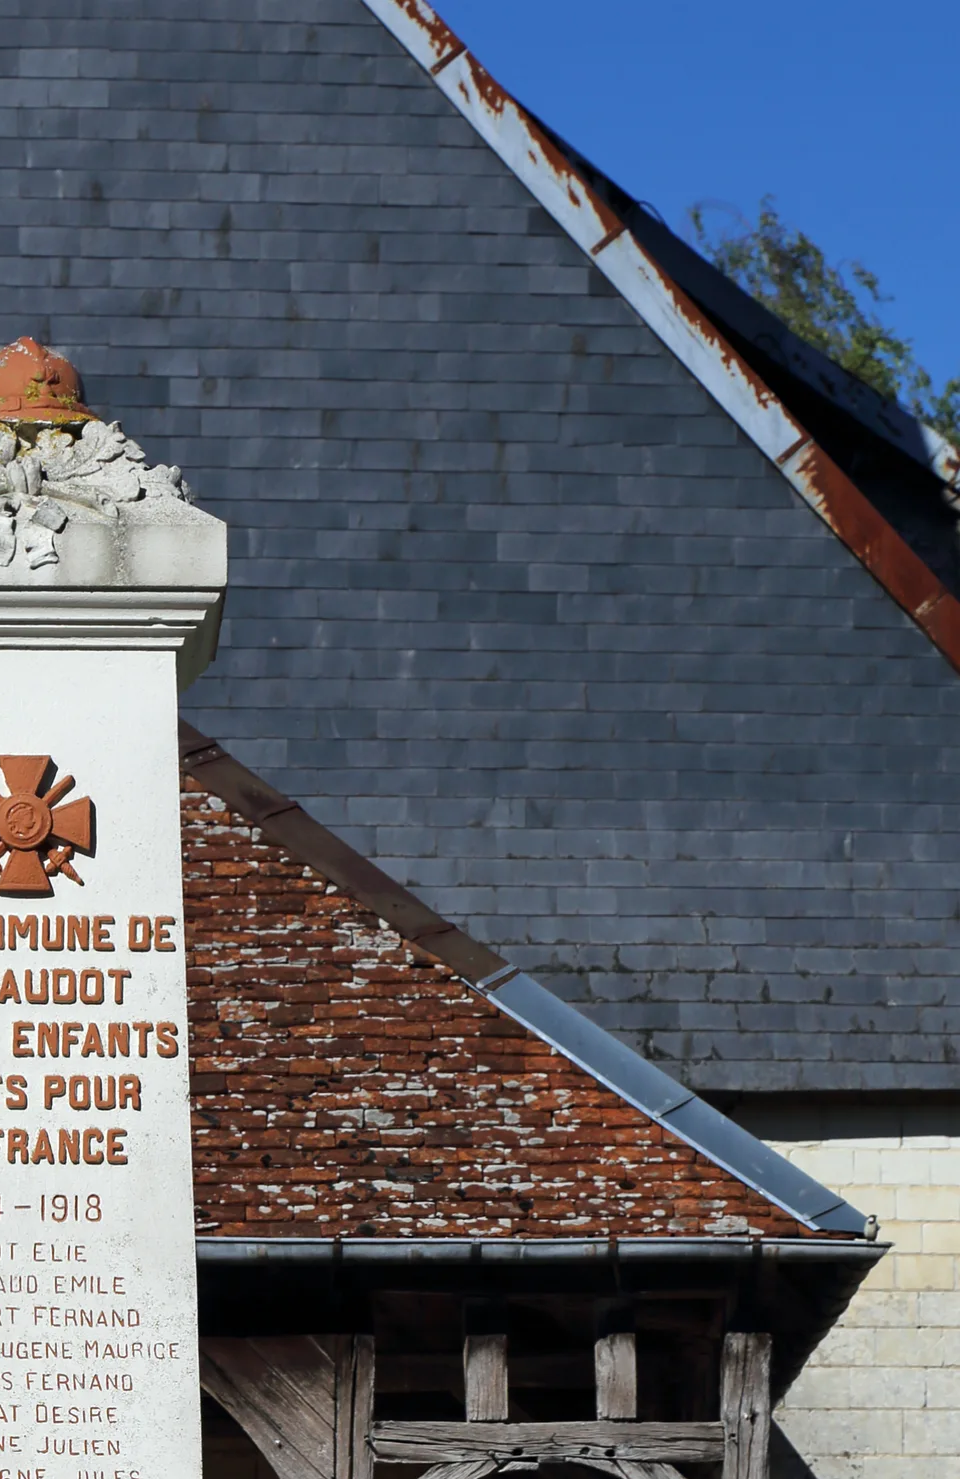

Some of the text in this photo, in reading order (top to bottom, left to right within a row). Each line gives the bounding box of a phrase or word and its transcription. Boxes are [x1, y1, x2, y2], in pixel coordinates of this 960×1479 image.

[128, 915, 176, 952] DE
[12, 1021, 179, 1058] ENFANTS
[44, 1074, 142, 1111] POUR
[33, 1243, 88, 1263] ELIE
[54, 1276, 126, 1295] EMILE
[33, 1307, 140, 1327] FERNAND
[85, 1341, 181, 1360] MAURICE
[26, 1372, 133, 1392] FERNAND
[36, 1404, 118, 1424] DESIRE
[36, 1437, 121, 1456] JULIEN
